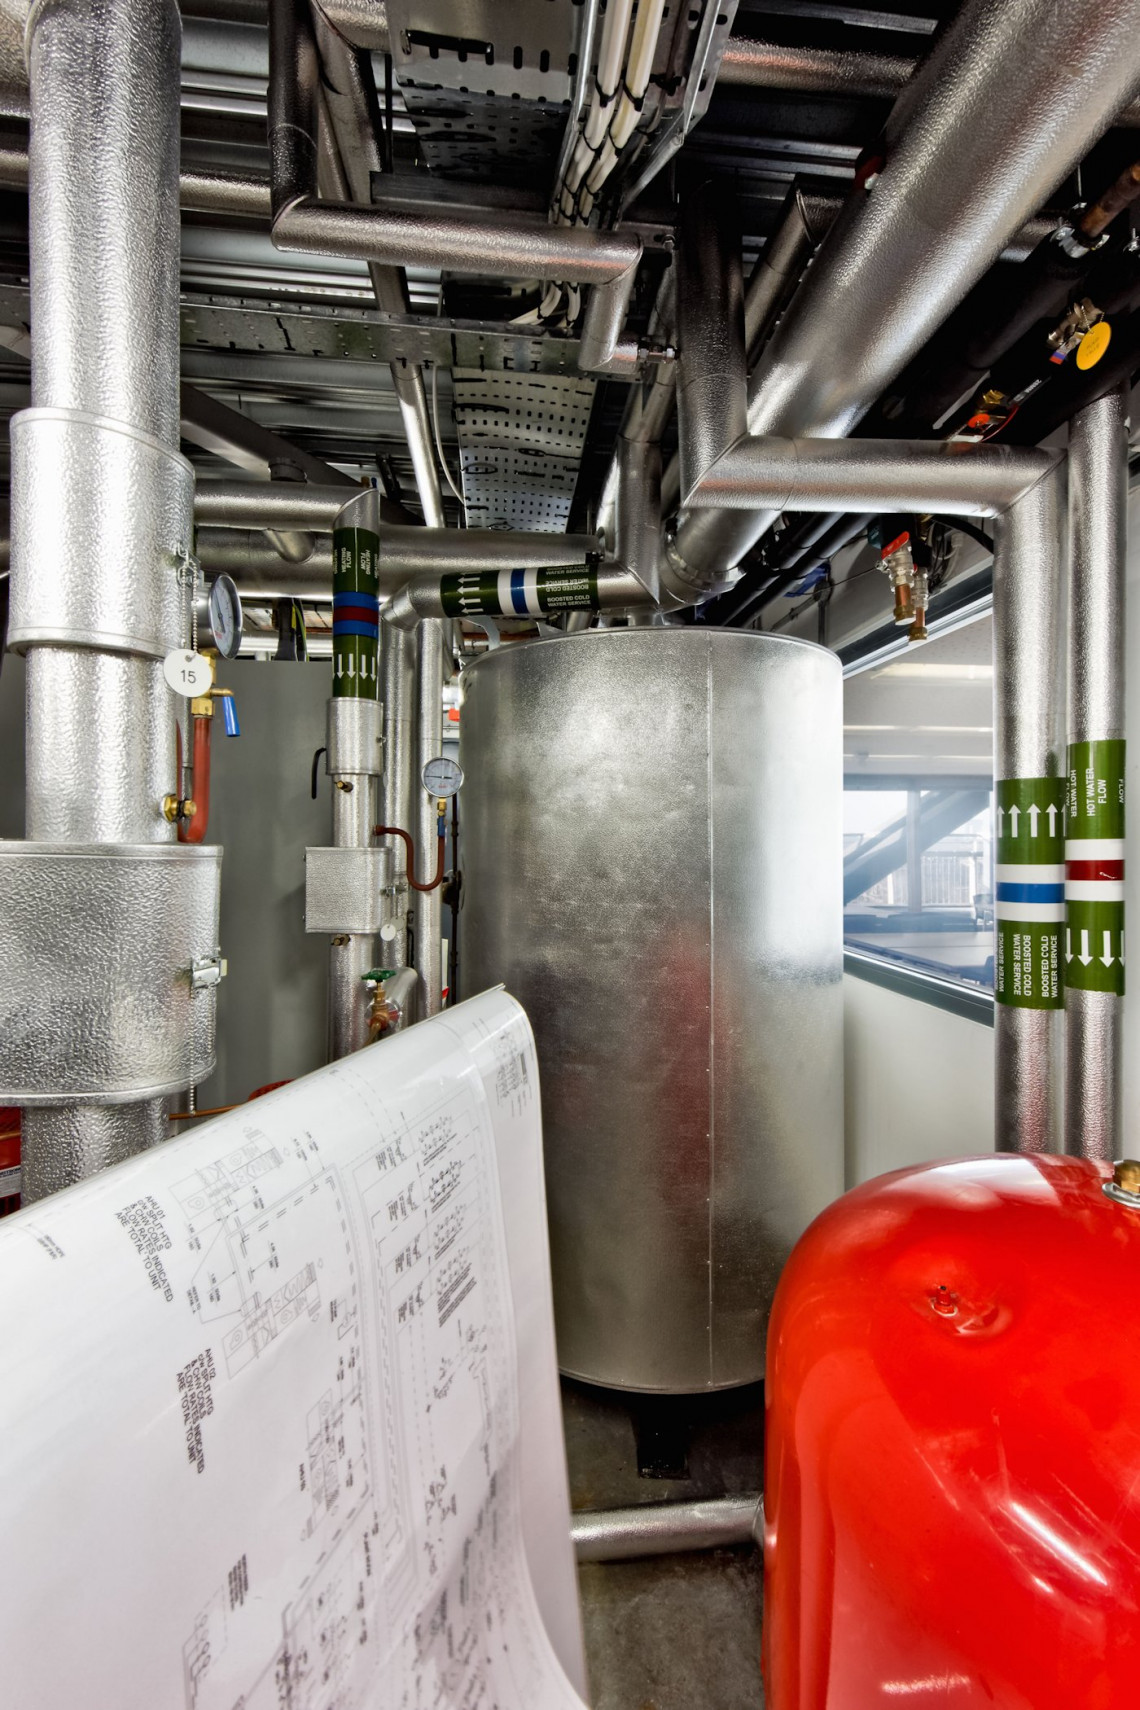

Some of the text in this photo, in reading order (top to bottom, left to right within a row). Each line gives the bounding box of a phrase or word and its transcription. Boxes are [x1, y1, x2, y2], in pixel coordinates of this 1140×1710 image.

[180, 670, 196, 684] 15
[1086, 768, 1096, 816] HOT WATER
[1097, 779, 1107, 804] FLOW
[1014, 962, 1022, 996] SERVICE
[1023, 935, 1032, 996] BOOSTED COLD
[1041, 936, 1050, 998] BOOSTED COLD
[135, 1208, 151, 1226] CHW
[148, 1226, 164, 1252] COILS
[146, 1196, 166, 1220] AHU 01
[146, 1210, 164, 1230] SPLIT
[160, 1231, 172, 1250] HTG
[115, 1212, 130, 1228] ARE
[143, 1256, 152, 1270] TO
[148, 1270, 162, 1290] UNIT
[122, 1206, 174, 1302] FLOW RATES INDICATED
[205, 1348, 214, 1368] AHU
[176, 1372, 186, 1393] ARE
[186, 1426, 194, 1442] TO
[201, 1368, 211, 1394] SPLIT
[206, 1394, 214, 1416] HTG
[184, 1364, 205, 1474] FLOW RATES INDICATED
